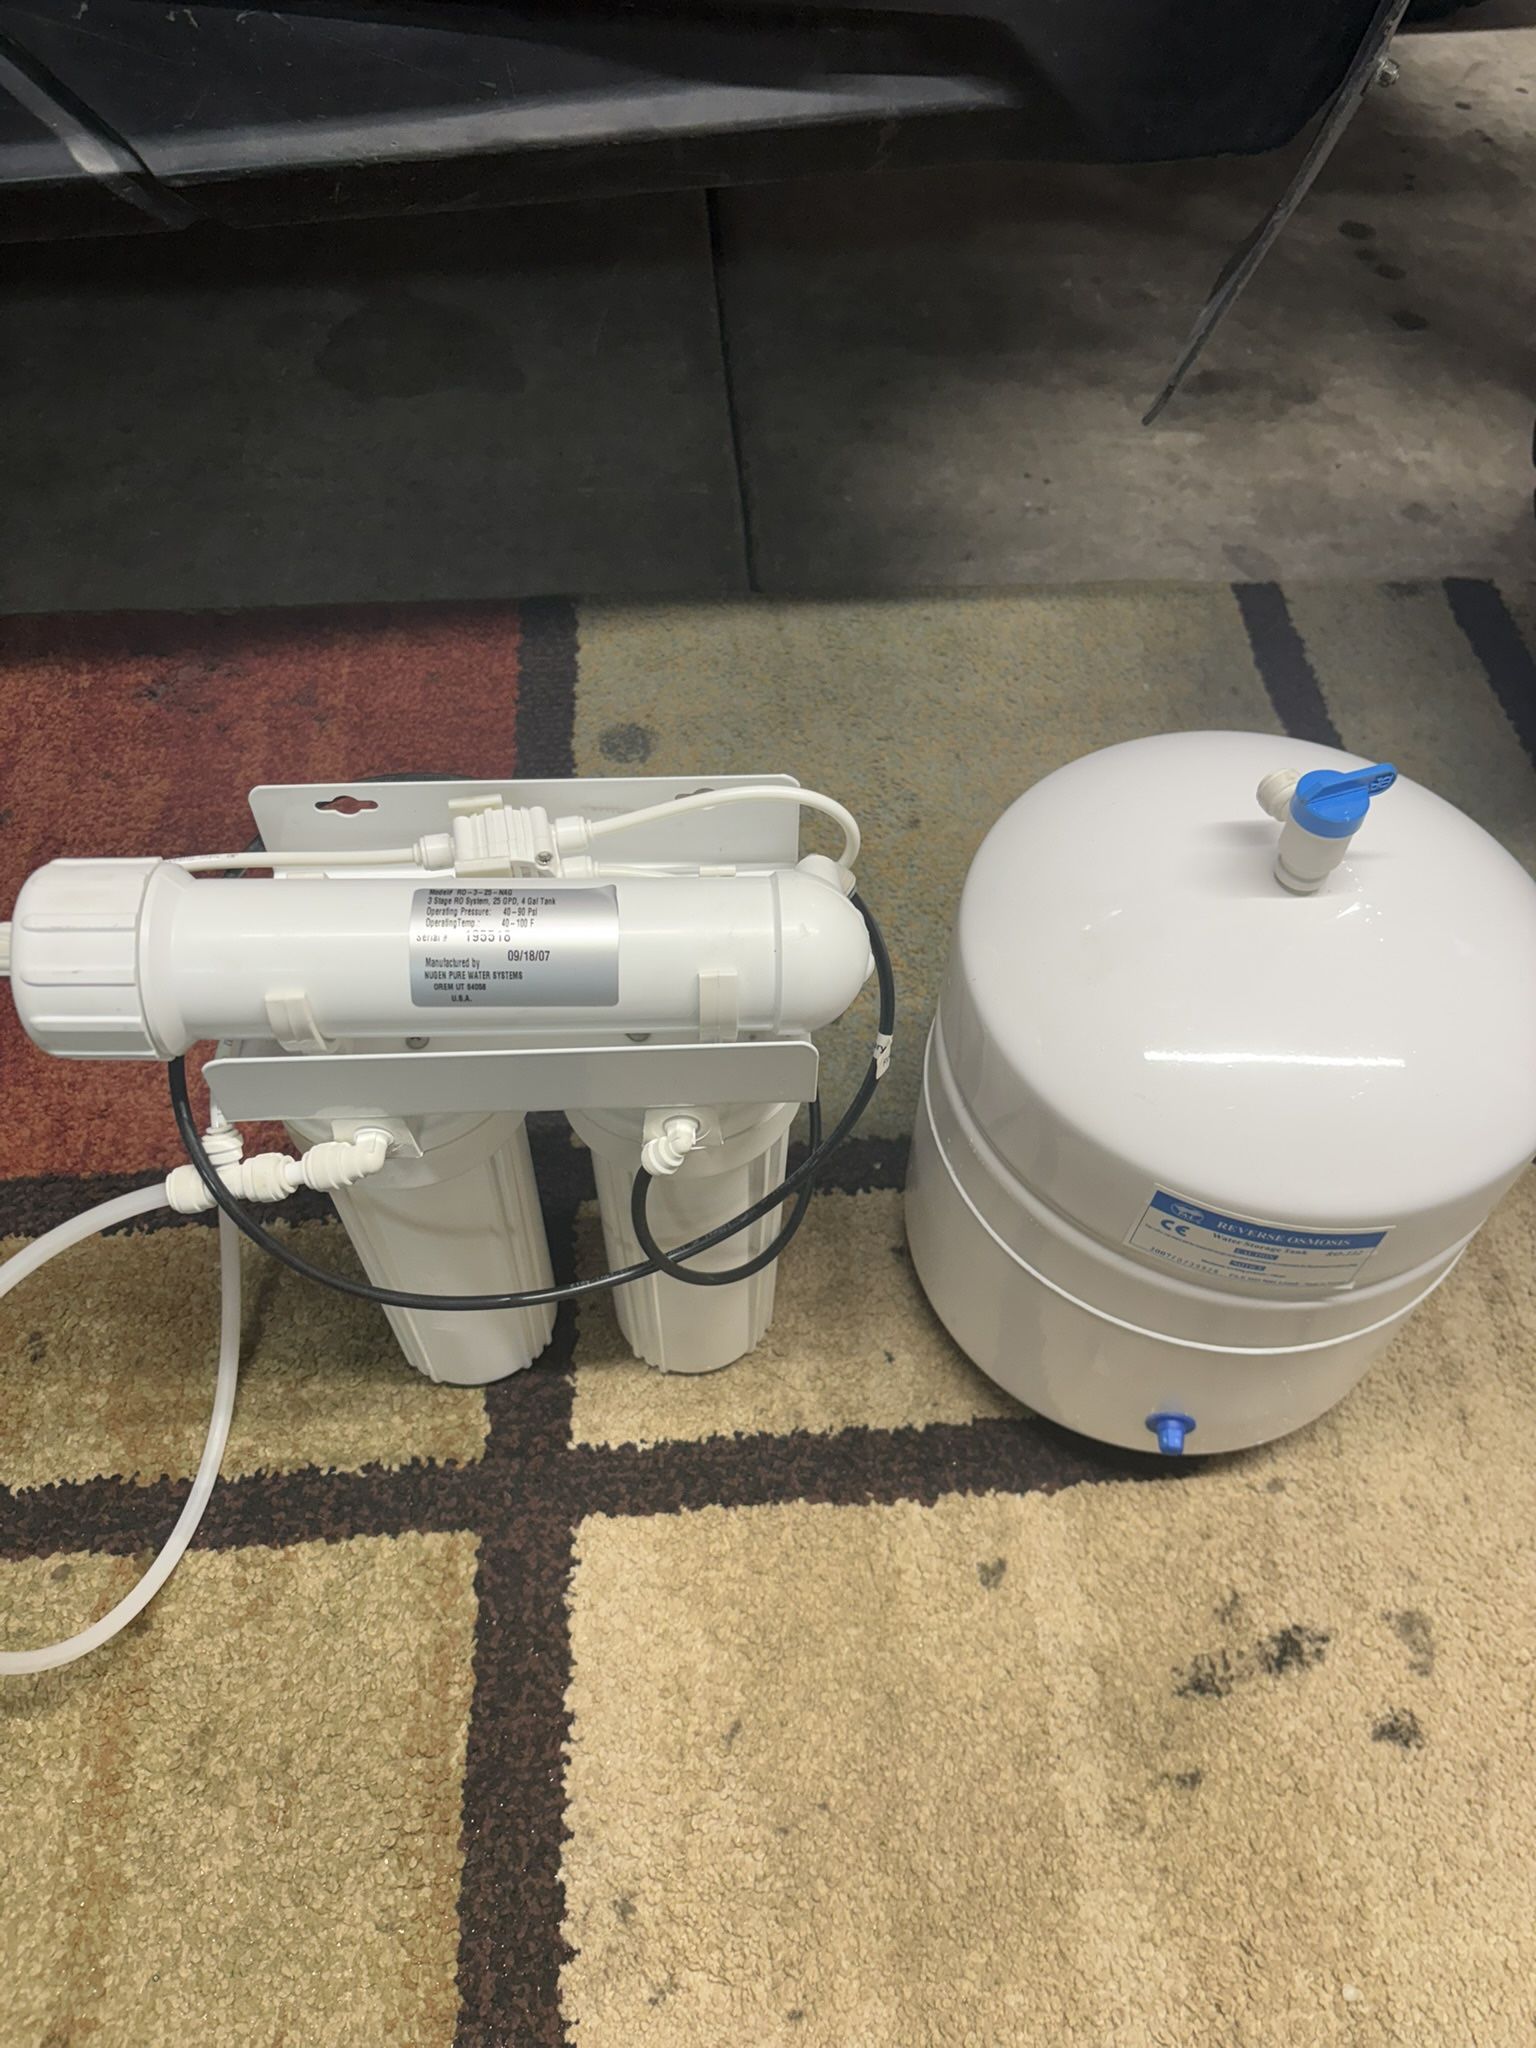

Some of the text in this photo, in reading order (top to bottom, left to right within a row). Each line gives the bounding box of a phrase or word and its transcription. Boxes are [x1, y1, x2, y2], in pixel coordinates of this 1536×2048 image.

[427, 897, 432, 905] 3
[433, 897, 452, 906] Stage
[454, 897, 464, 905] RO
[493, 897, 501, 905] 25
[521, 897, 526, 905] 4
[527, 897, 539, 905] Gal
[540, 897, 556, 905] Tank
[426, 907, 458, 917] Operating
[460, 907, 491, 916] Pressure:
[528, 907, 538, 916] Psi
[530, 919, 535, 928] F
[507, 950, 551, 961] 09/18/07
[425, 957, 480, 970] Manufactured by
[448, 971, 466, 980] PURE
[467, 971, 491, 980] WATER
[492, 971, 523, 980] SYSTEMS
[433, 983, 454, 991] OREM
[455, 983, 465, 991] UT
[1160, 1219, 1190, 1238] CE
[1216, 1220, 1351, 1247] REVERSE OSMOSIS
[1212, 1232, 1242, 1245] Water
